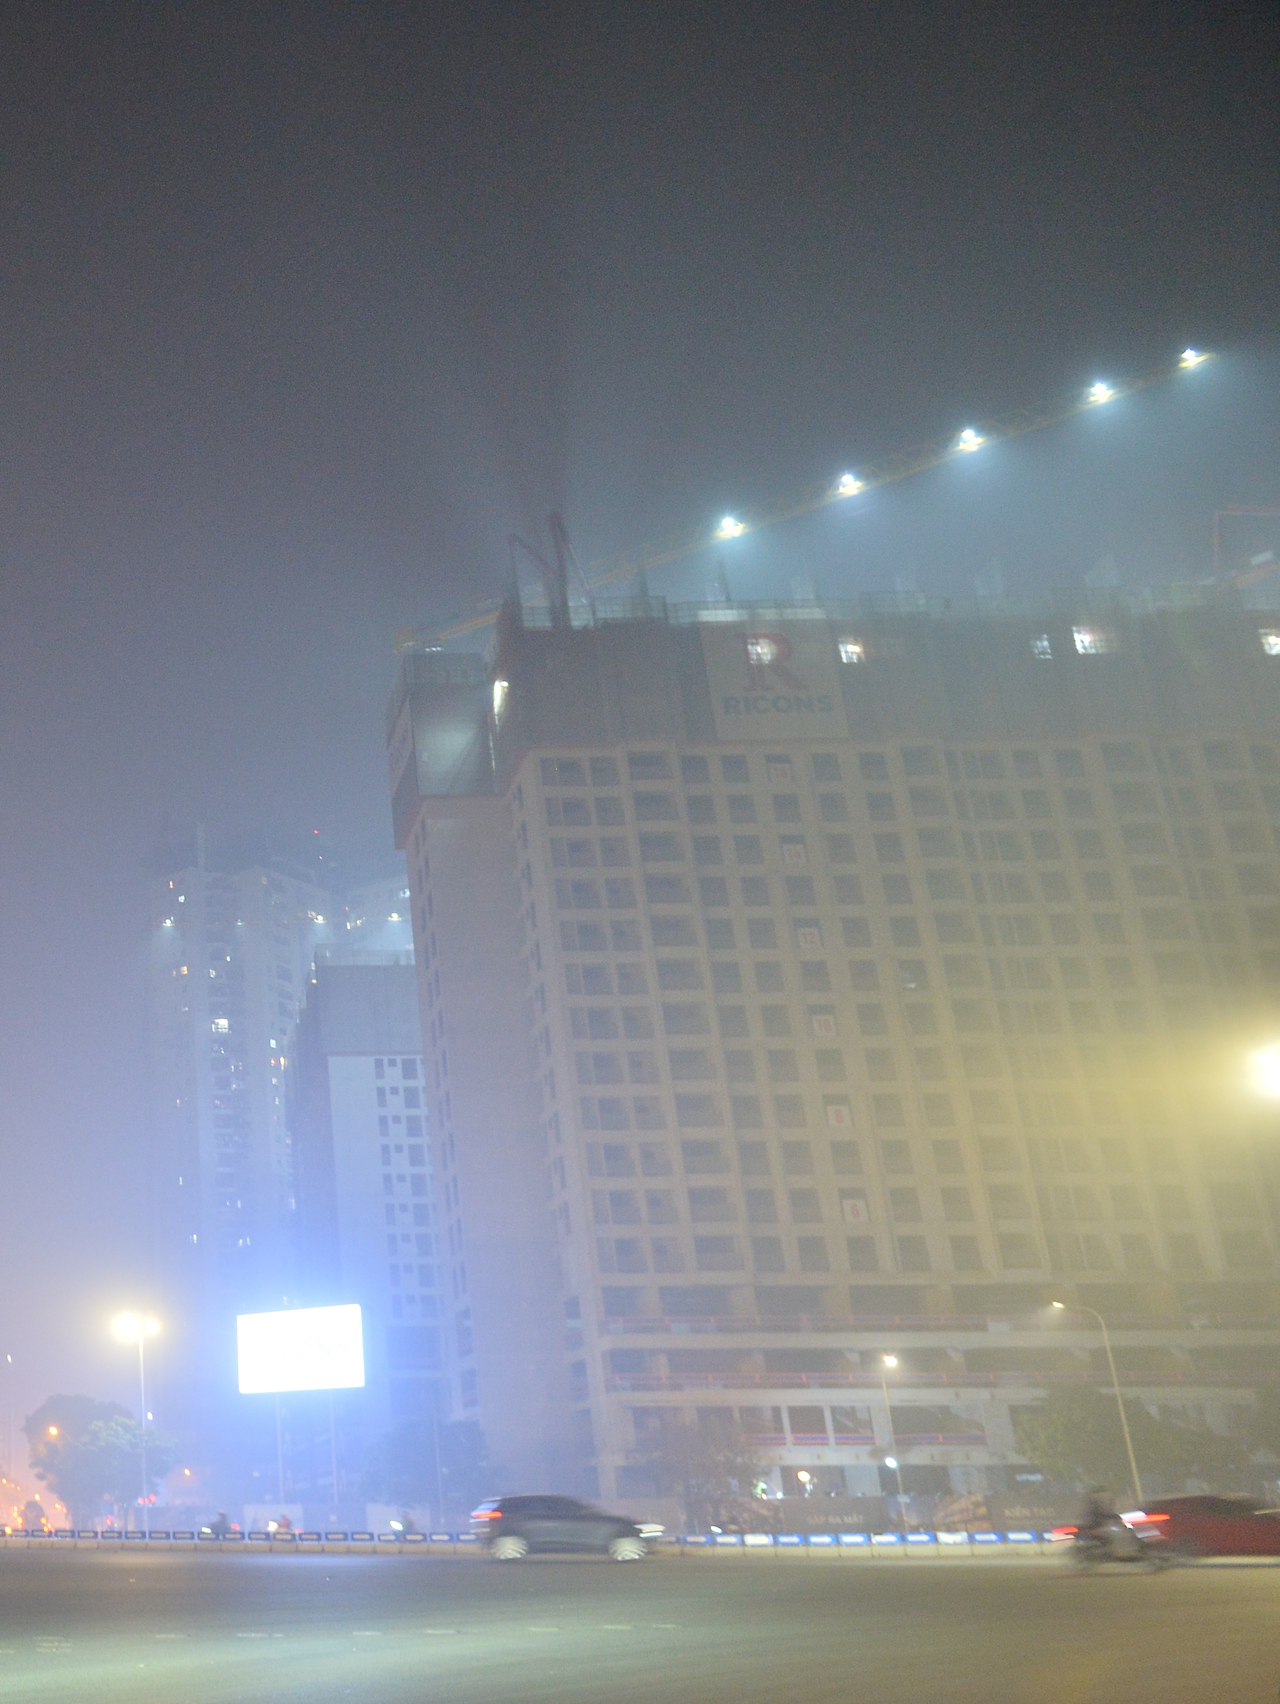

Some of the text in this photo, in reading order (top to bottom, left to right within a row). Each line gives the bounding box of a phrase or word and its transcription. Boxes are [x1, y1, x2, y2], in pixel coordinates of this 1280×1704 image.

[735, 631, 805, 691] R
[723, 695, 834, 714] RICONS
[801, 931, 816, 944] 12
[816, 1018, 832, 1031] 10
